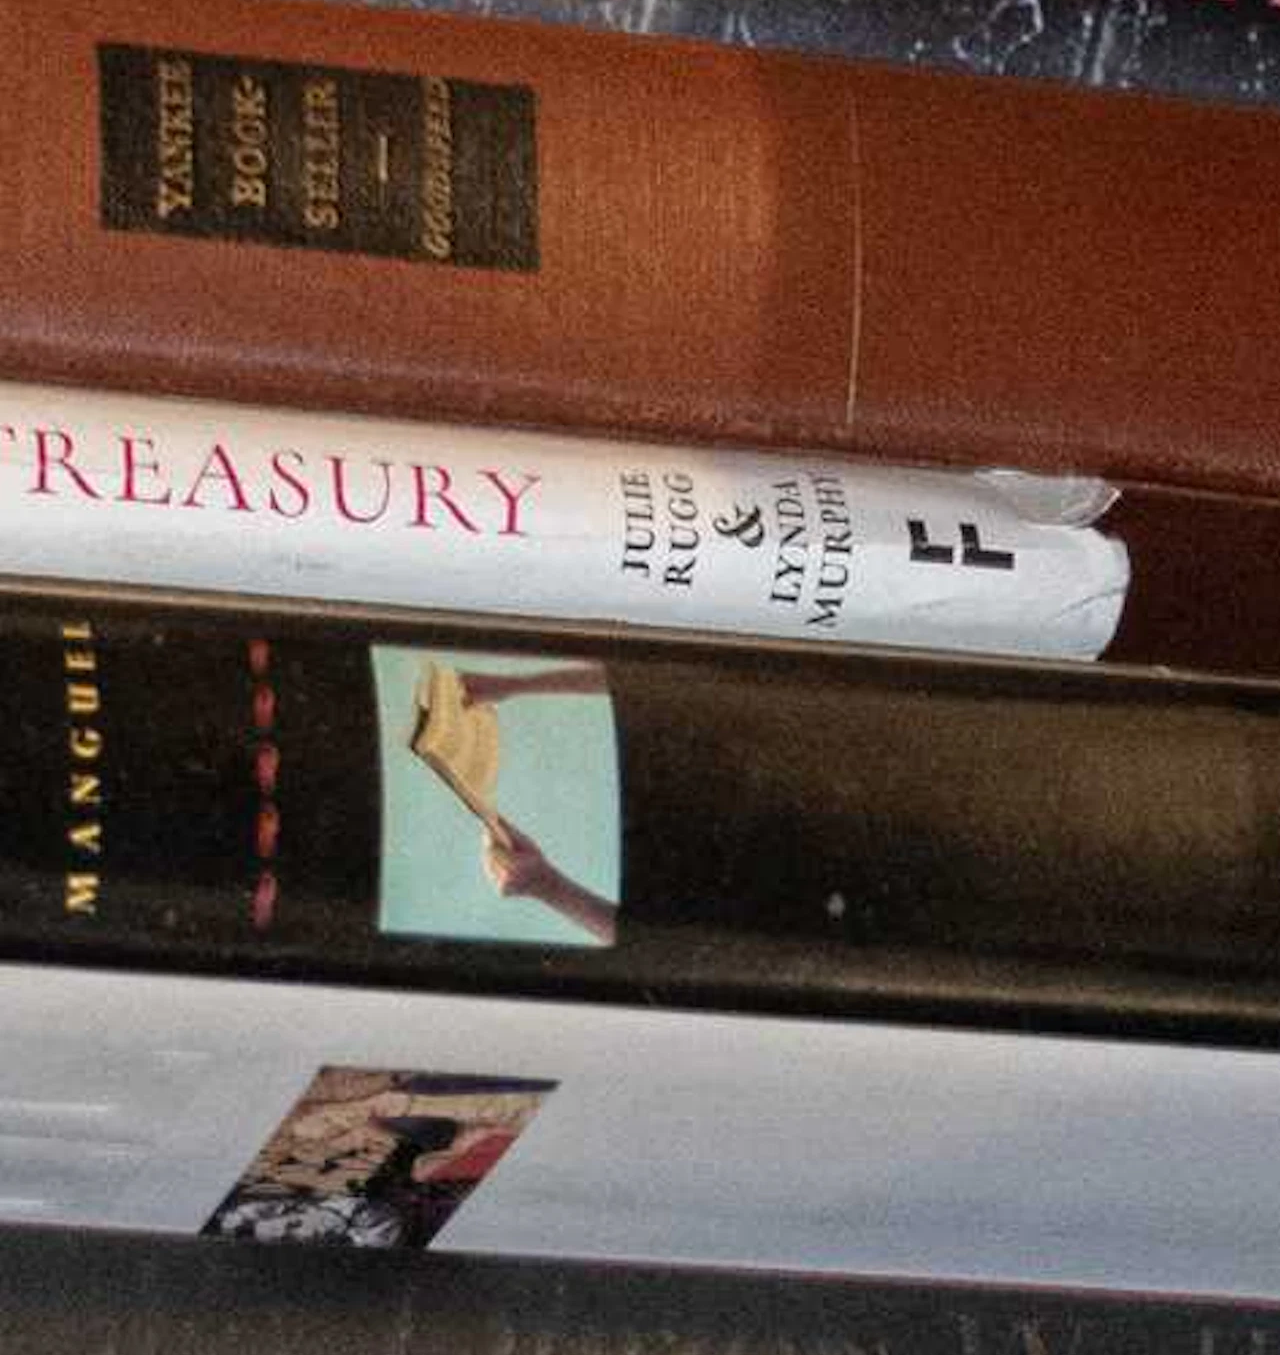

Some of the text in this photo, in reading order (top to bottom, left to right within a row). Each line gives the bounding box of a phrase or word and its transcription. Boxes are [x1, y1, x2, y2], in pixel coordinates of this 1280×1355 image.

[155, 58, 195, 220] YANKEE
[304, 79, 341, 231] SELLER
[621, 469, 656, 578] JULIE
[661, 469, 701, 589] RUGG
[712, 502, 766, 548] &
[769, 478, 808, 605] LYNDA
[806, 467, 853, 629] MURPHY
[61, 621, 101, 916] MANGUEL
